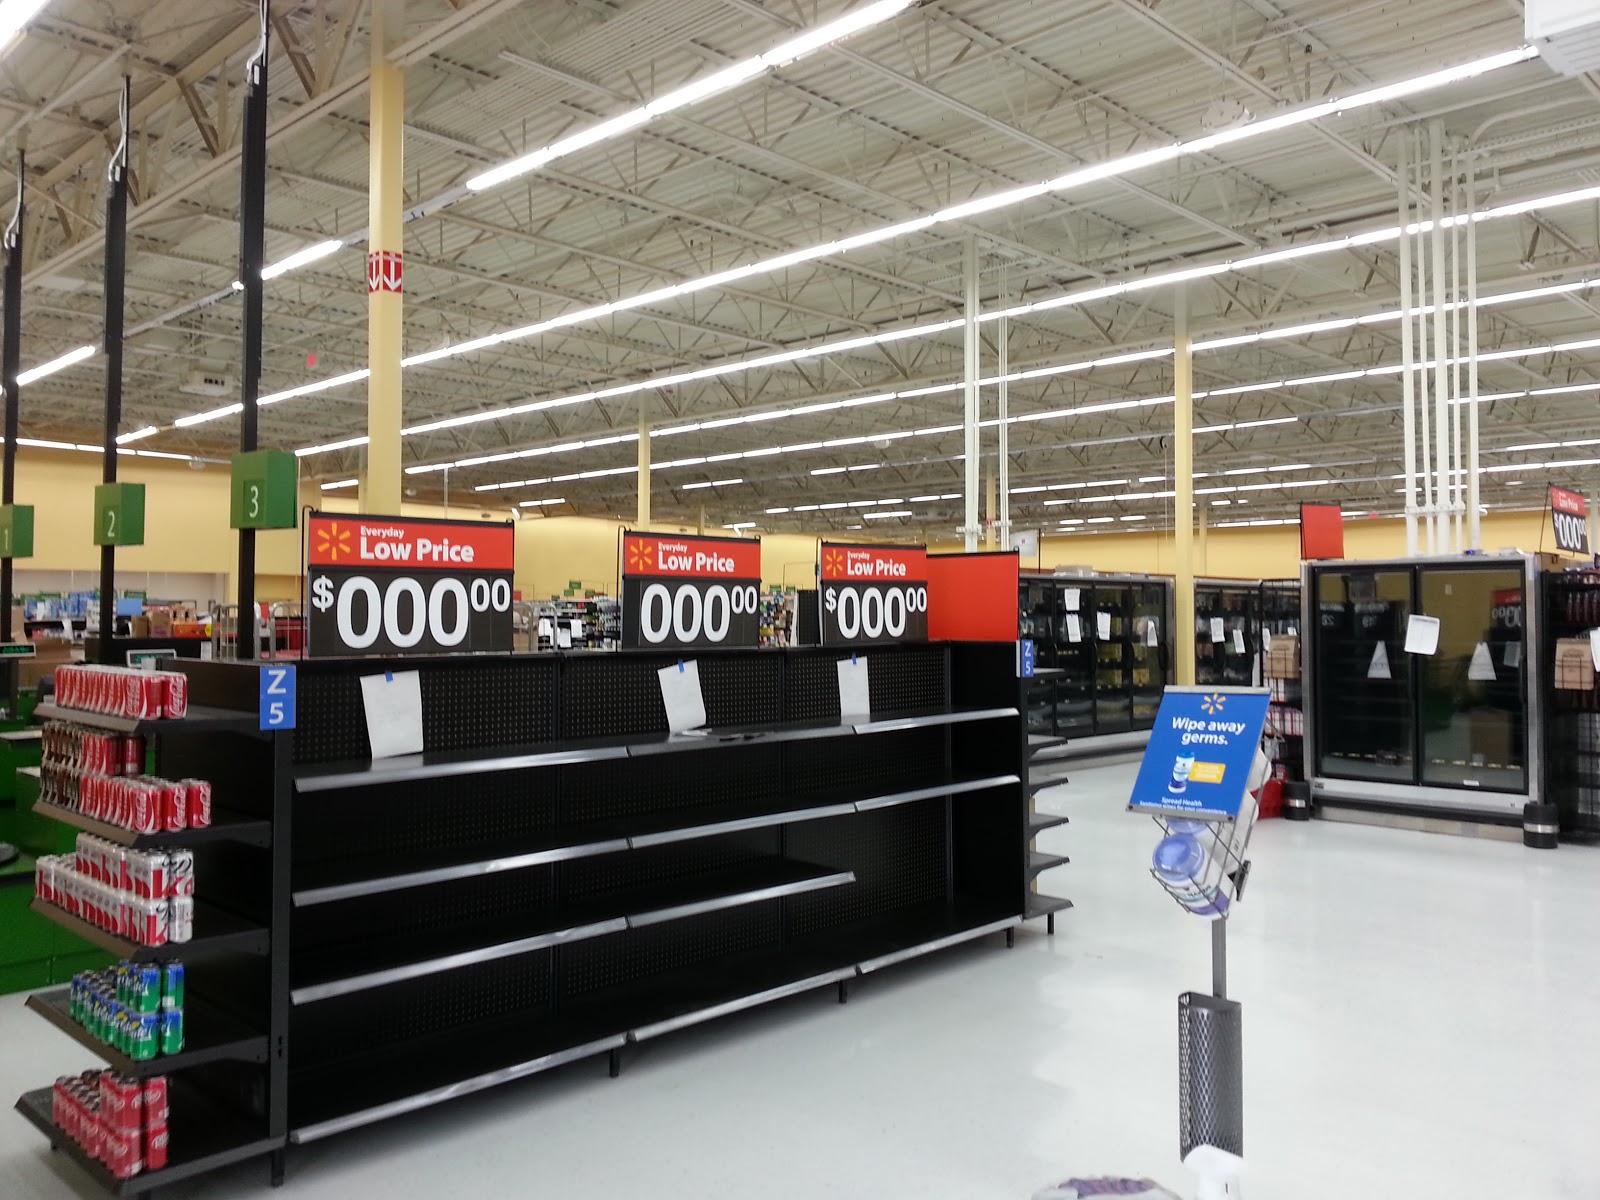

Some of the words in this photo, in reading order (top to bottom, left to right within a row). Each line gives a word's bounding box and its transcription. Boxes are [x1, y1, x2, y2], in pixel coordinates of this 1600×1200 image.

[248, 485, 259, 518] 3
[107, 510, 115, 538] 2
[360, 525, 405, 539] Everyday
[4, 528, 9, 551] 1
[658, 541, 688, 553] Everyday
[360, 536, 412, 560] Low
[416, 538, 475, 562] Price
[847, 550, 870, 561] Everyday
[658, 551, 692, 571] Low
[695, 552, 735, 572] Price
[847, 559, 873, 576] Low
[875, 559, 906, 576] Price
[1025, 642, 1031, 657] Z
[1026, 661, 1031, 675] 5
[267, 669, 287, 695] Z
[269, 702, 284, 725] 5
[1172, 717, 1206, 731] Wipe
[1207, 720, 1246, 735] away
[1181, 732, 1229, 746] germs.
